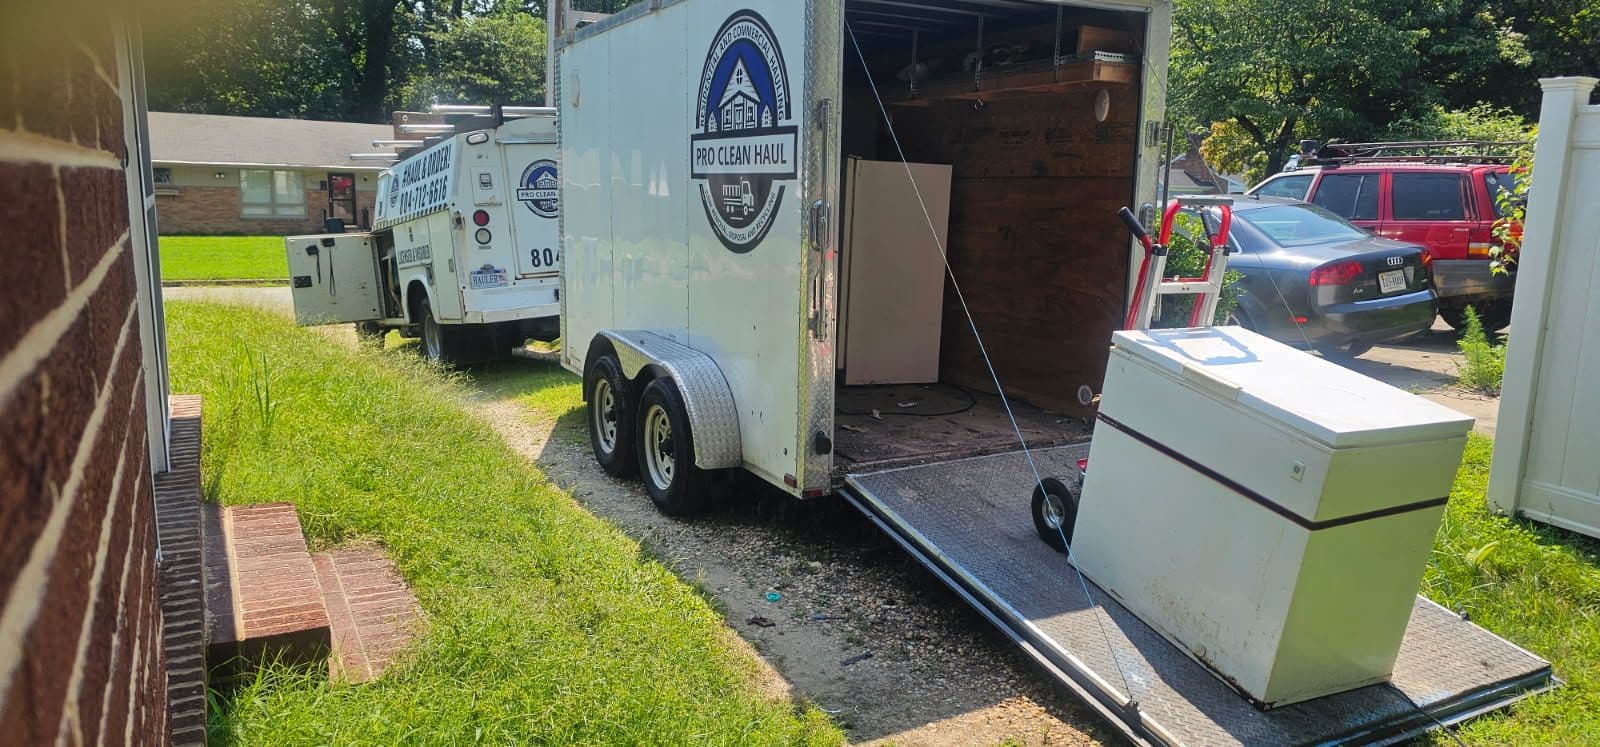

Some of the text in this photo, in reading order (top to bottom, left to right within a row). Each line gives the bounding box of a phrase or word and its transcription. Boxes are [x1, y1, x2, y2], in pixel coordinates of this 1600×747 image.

[700, 24, 785, 127] RESIDENTIAL AND COMMERCIAL HAULING
[427, 143, 452, 179] ORDER!
[696, 142, 787, 167] PRO CLEAN HAUL
[399, 175, 448, 216] 804-712-6616
[472, 274, 498, 285] HAULER
